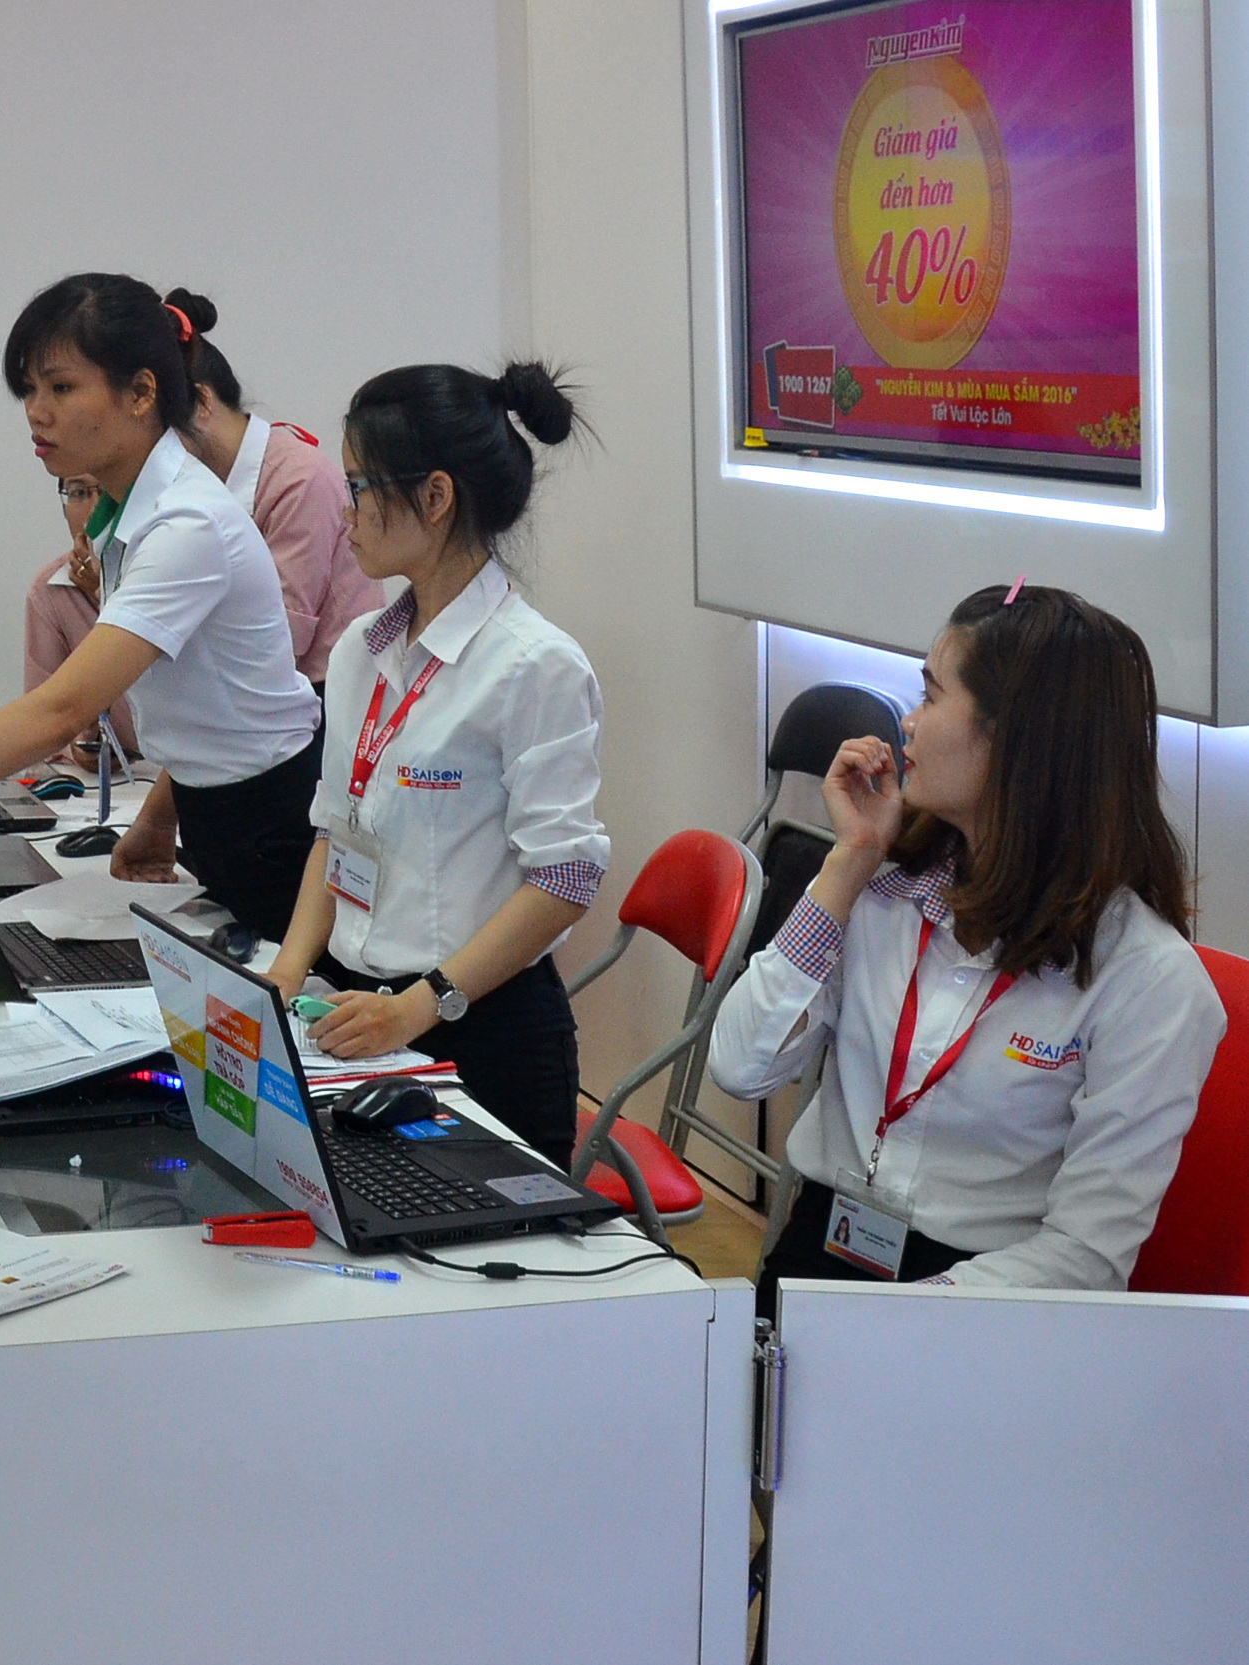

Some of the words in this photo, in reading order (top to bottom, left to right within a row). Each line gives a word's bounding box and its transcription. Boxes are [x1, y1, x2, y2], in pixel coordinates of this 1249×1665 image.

[874, 123, 921, 157] Giảm
[926, 117, 957, 160] giá
[881, 173, 913, 210] đến
[918, 176, 953, 207] hơn
[865, 225, 977, 306] 40%
[779, 375, 804, 394] 1900
[806, 376, 831, 395] 1267
[950, 405, 967, 422] Vui
